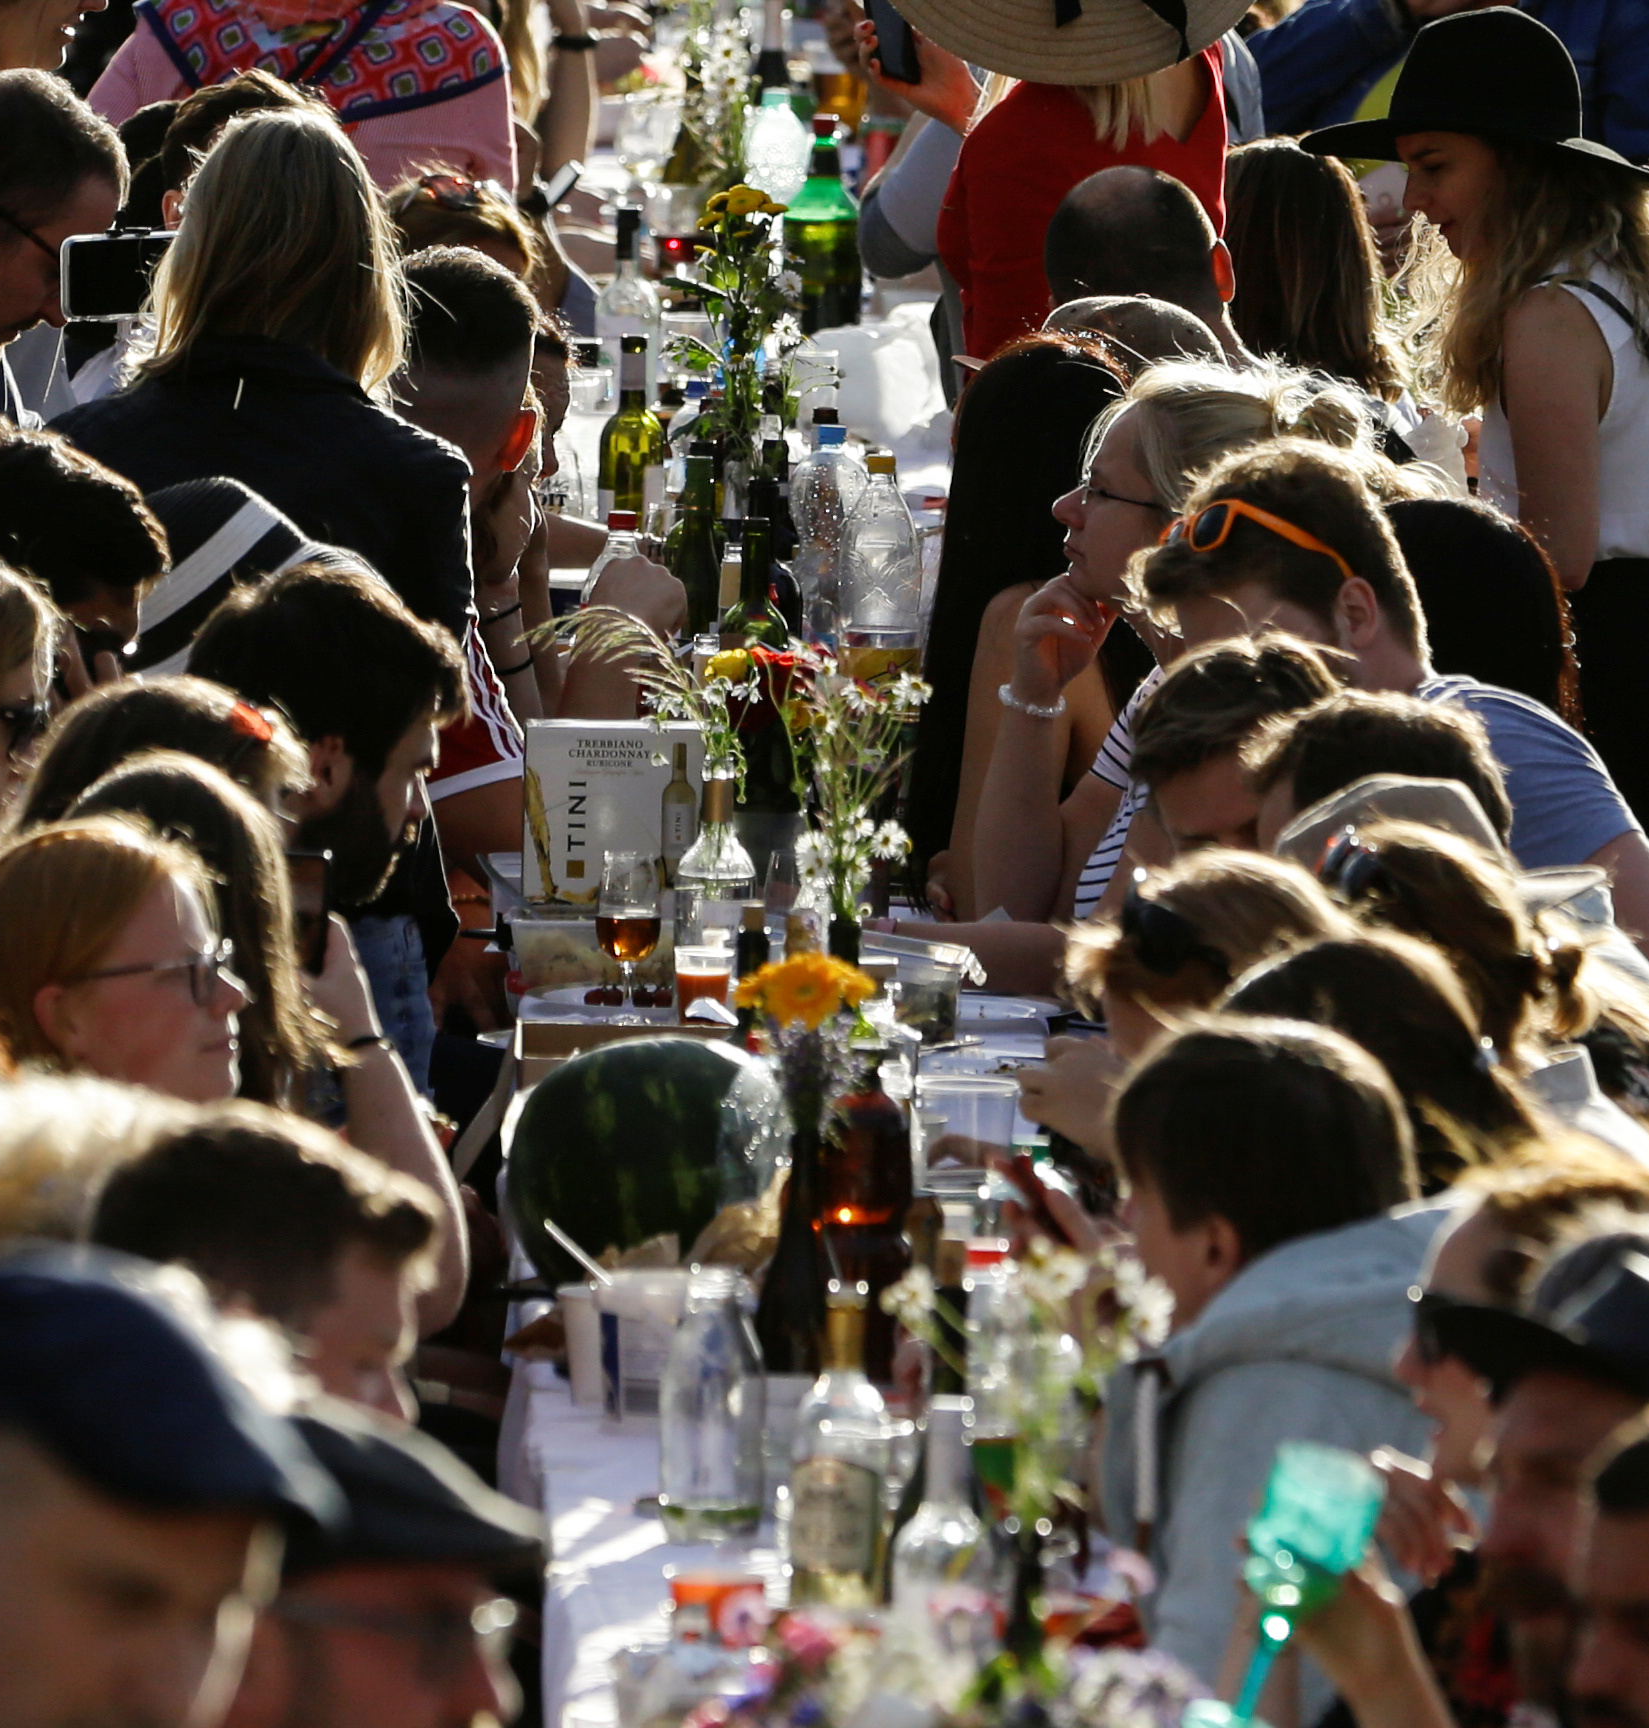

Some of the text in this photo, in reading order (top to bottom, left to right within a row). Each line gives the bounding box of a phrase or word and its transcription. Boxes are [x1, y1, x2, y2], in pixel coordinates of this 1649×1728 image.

[577, 739, 644, 749] TREBBIANO
[568, 749, 651, 760] CHARDONNAY
[586, 760, 633, 768] RUBICONE
[567, 780, 587, 852] TINI
